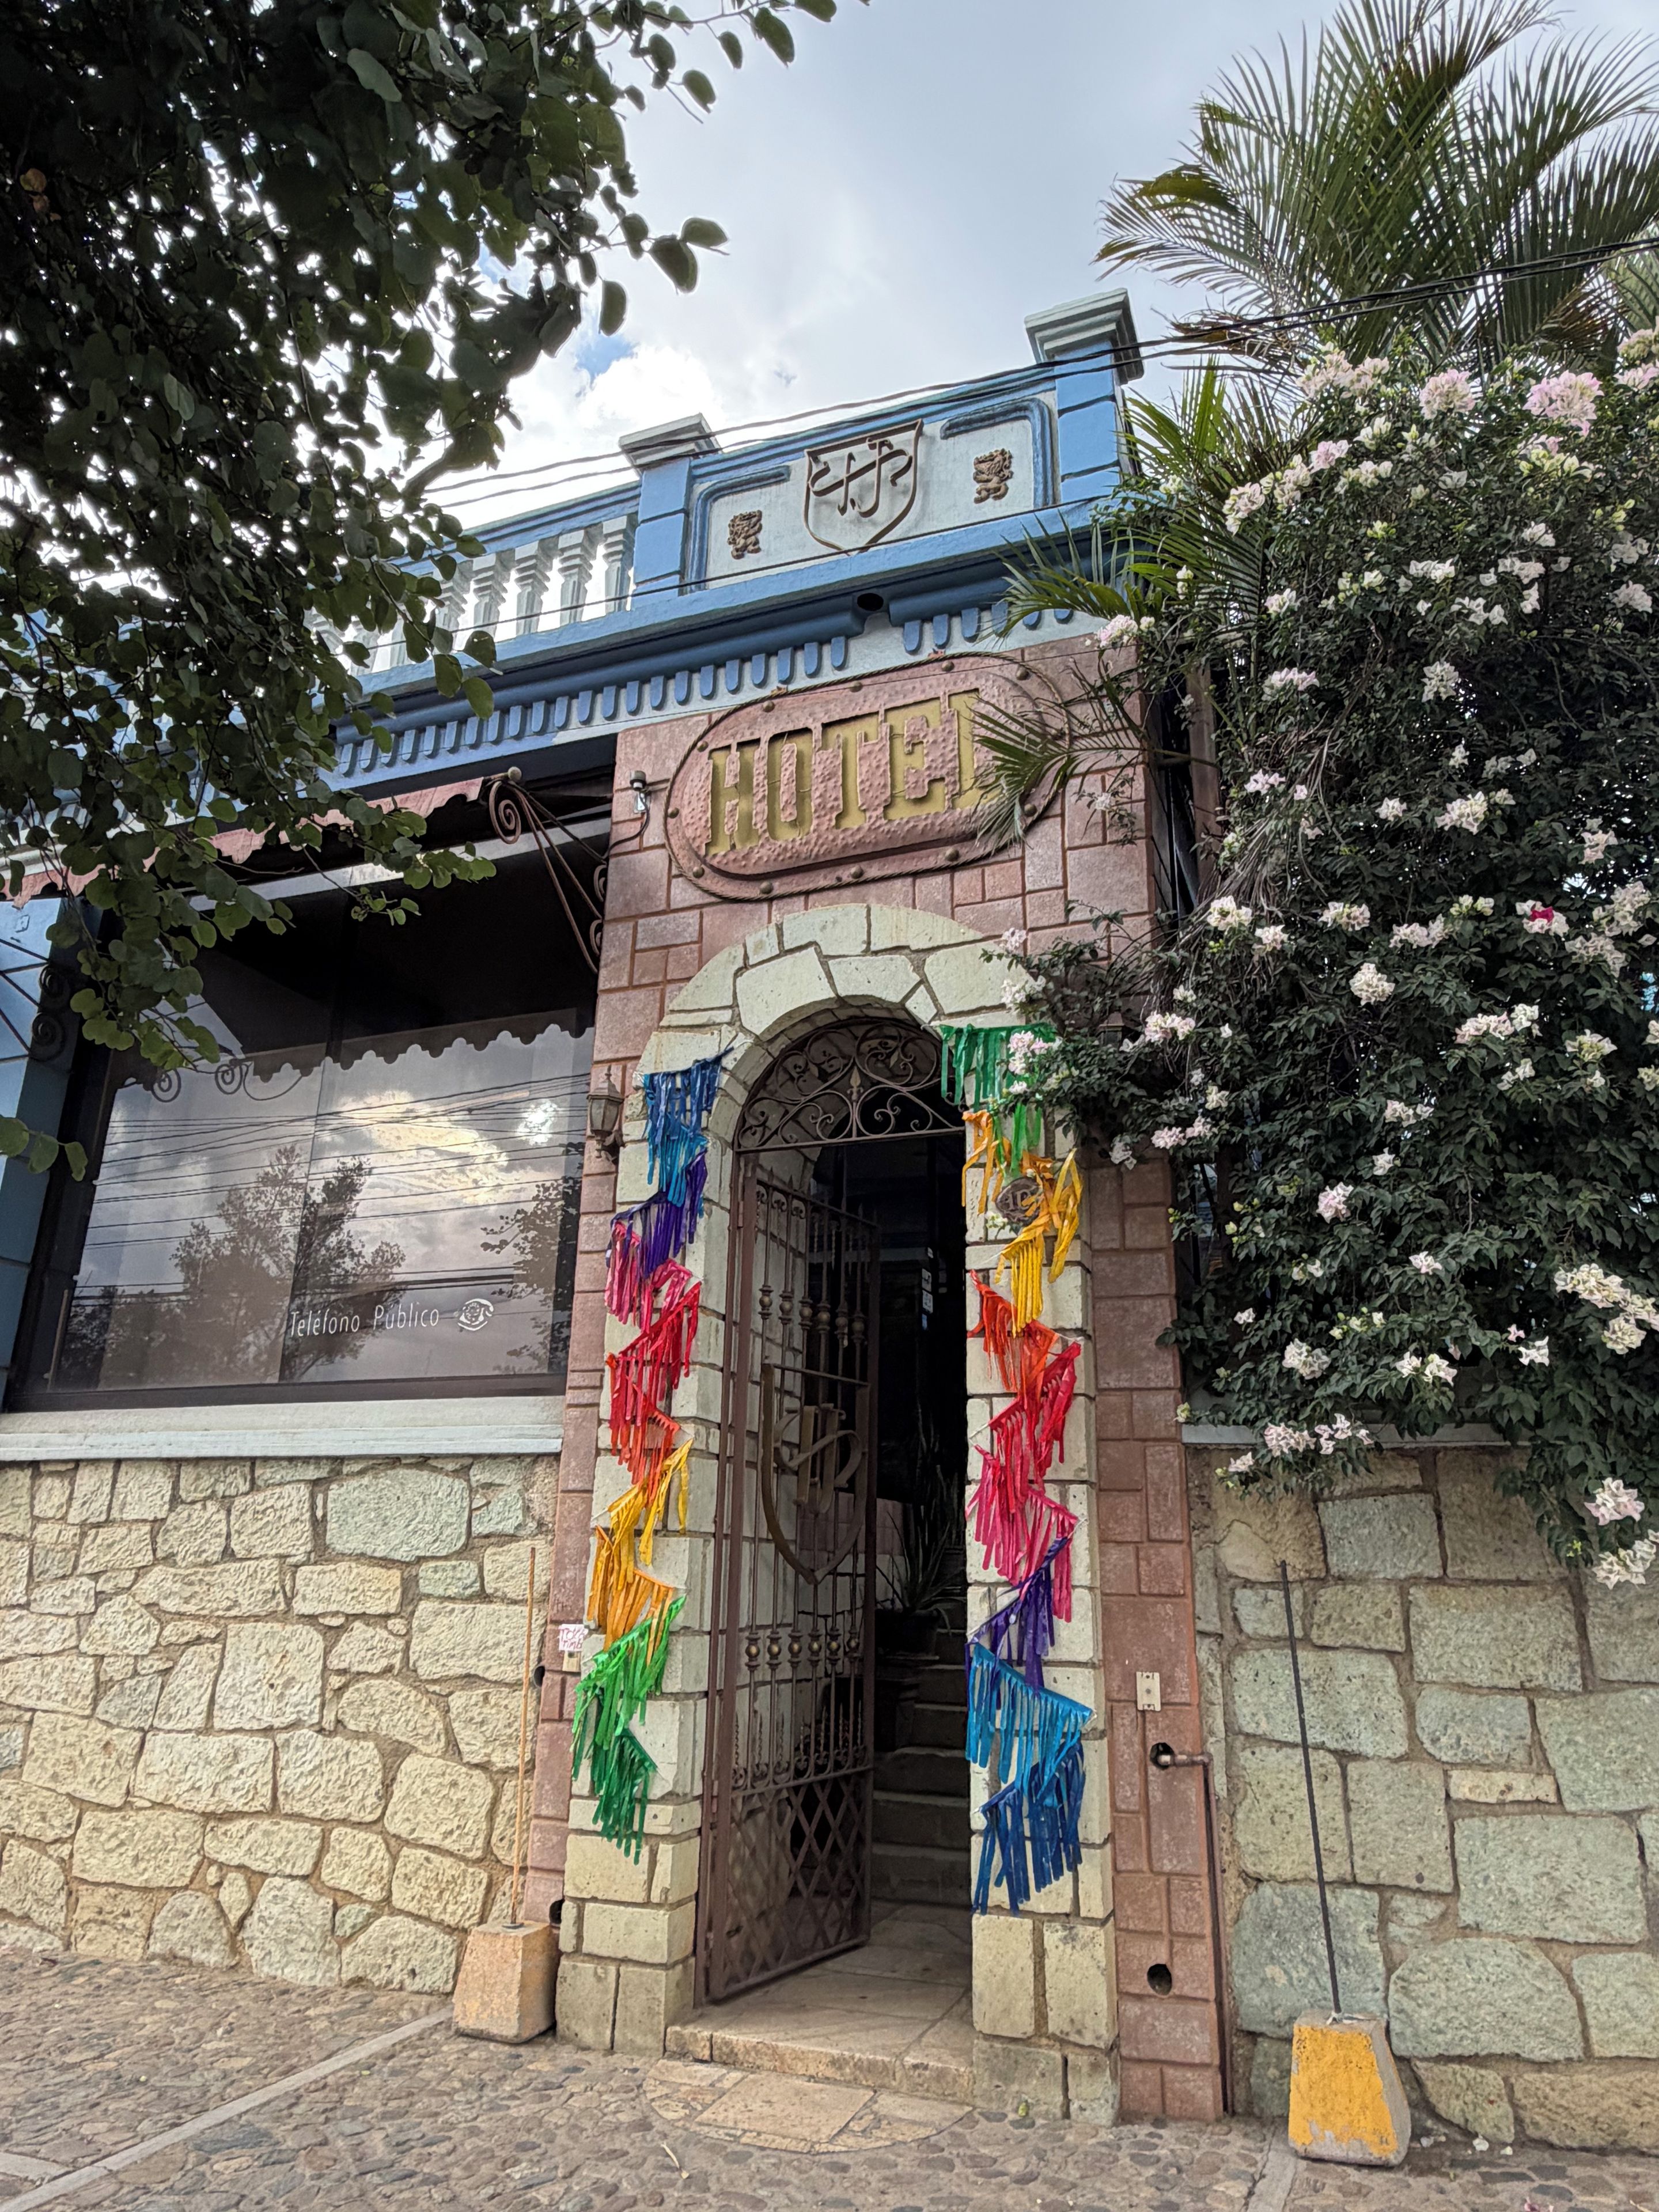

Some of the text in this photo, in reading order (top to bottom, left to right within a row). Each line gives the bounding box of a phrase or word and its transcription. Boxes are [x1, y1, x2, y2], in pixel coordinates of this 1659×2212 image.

[704, 687, 1003, 855] HOTEL
[290, 1301, 440, 1337] Teléfono Público
